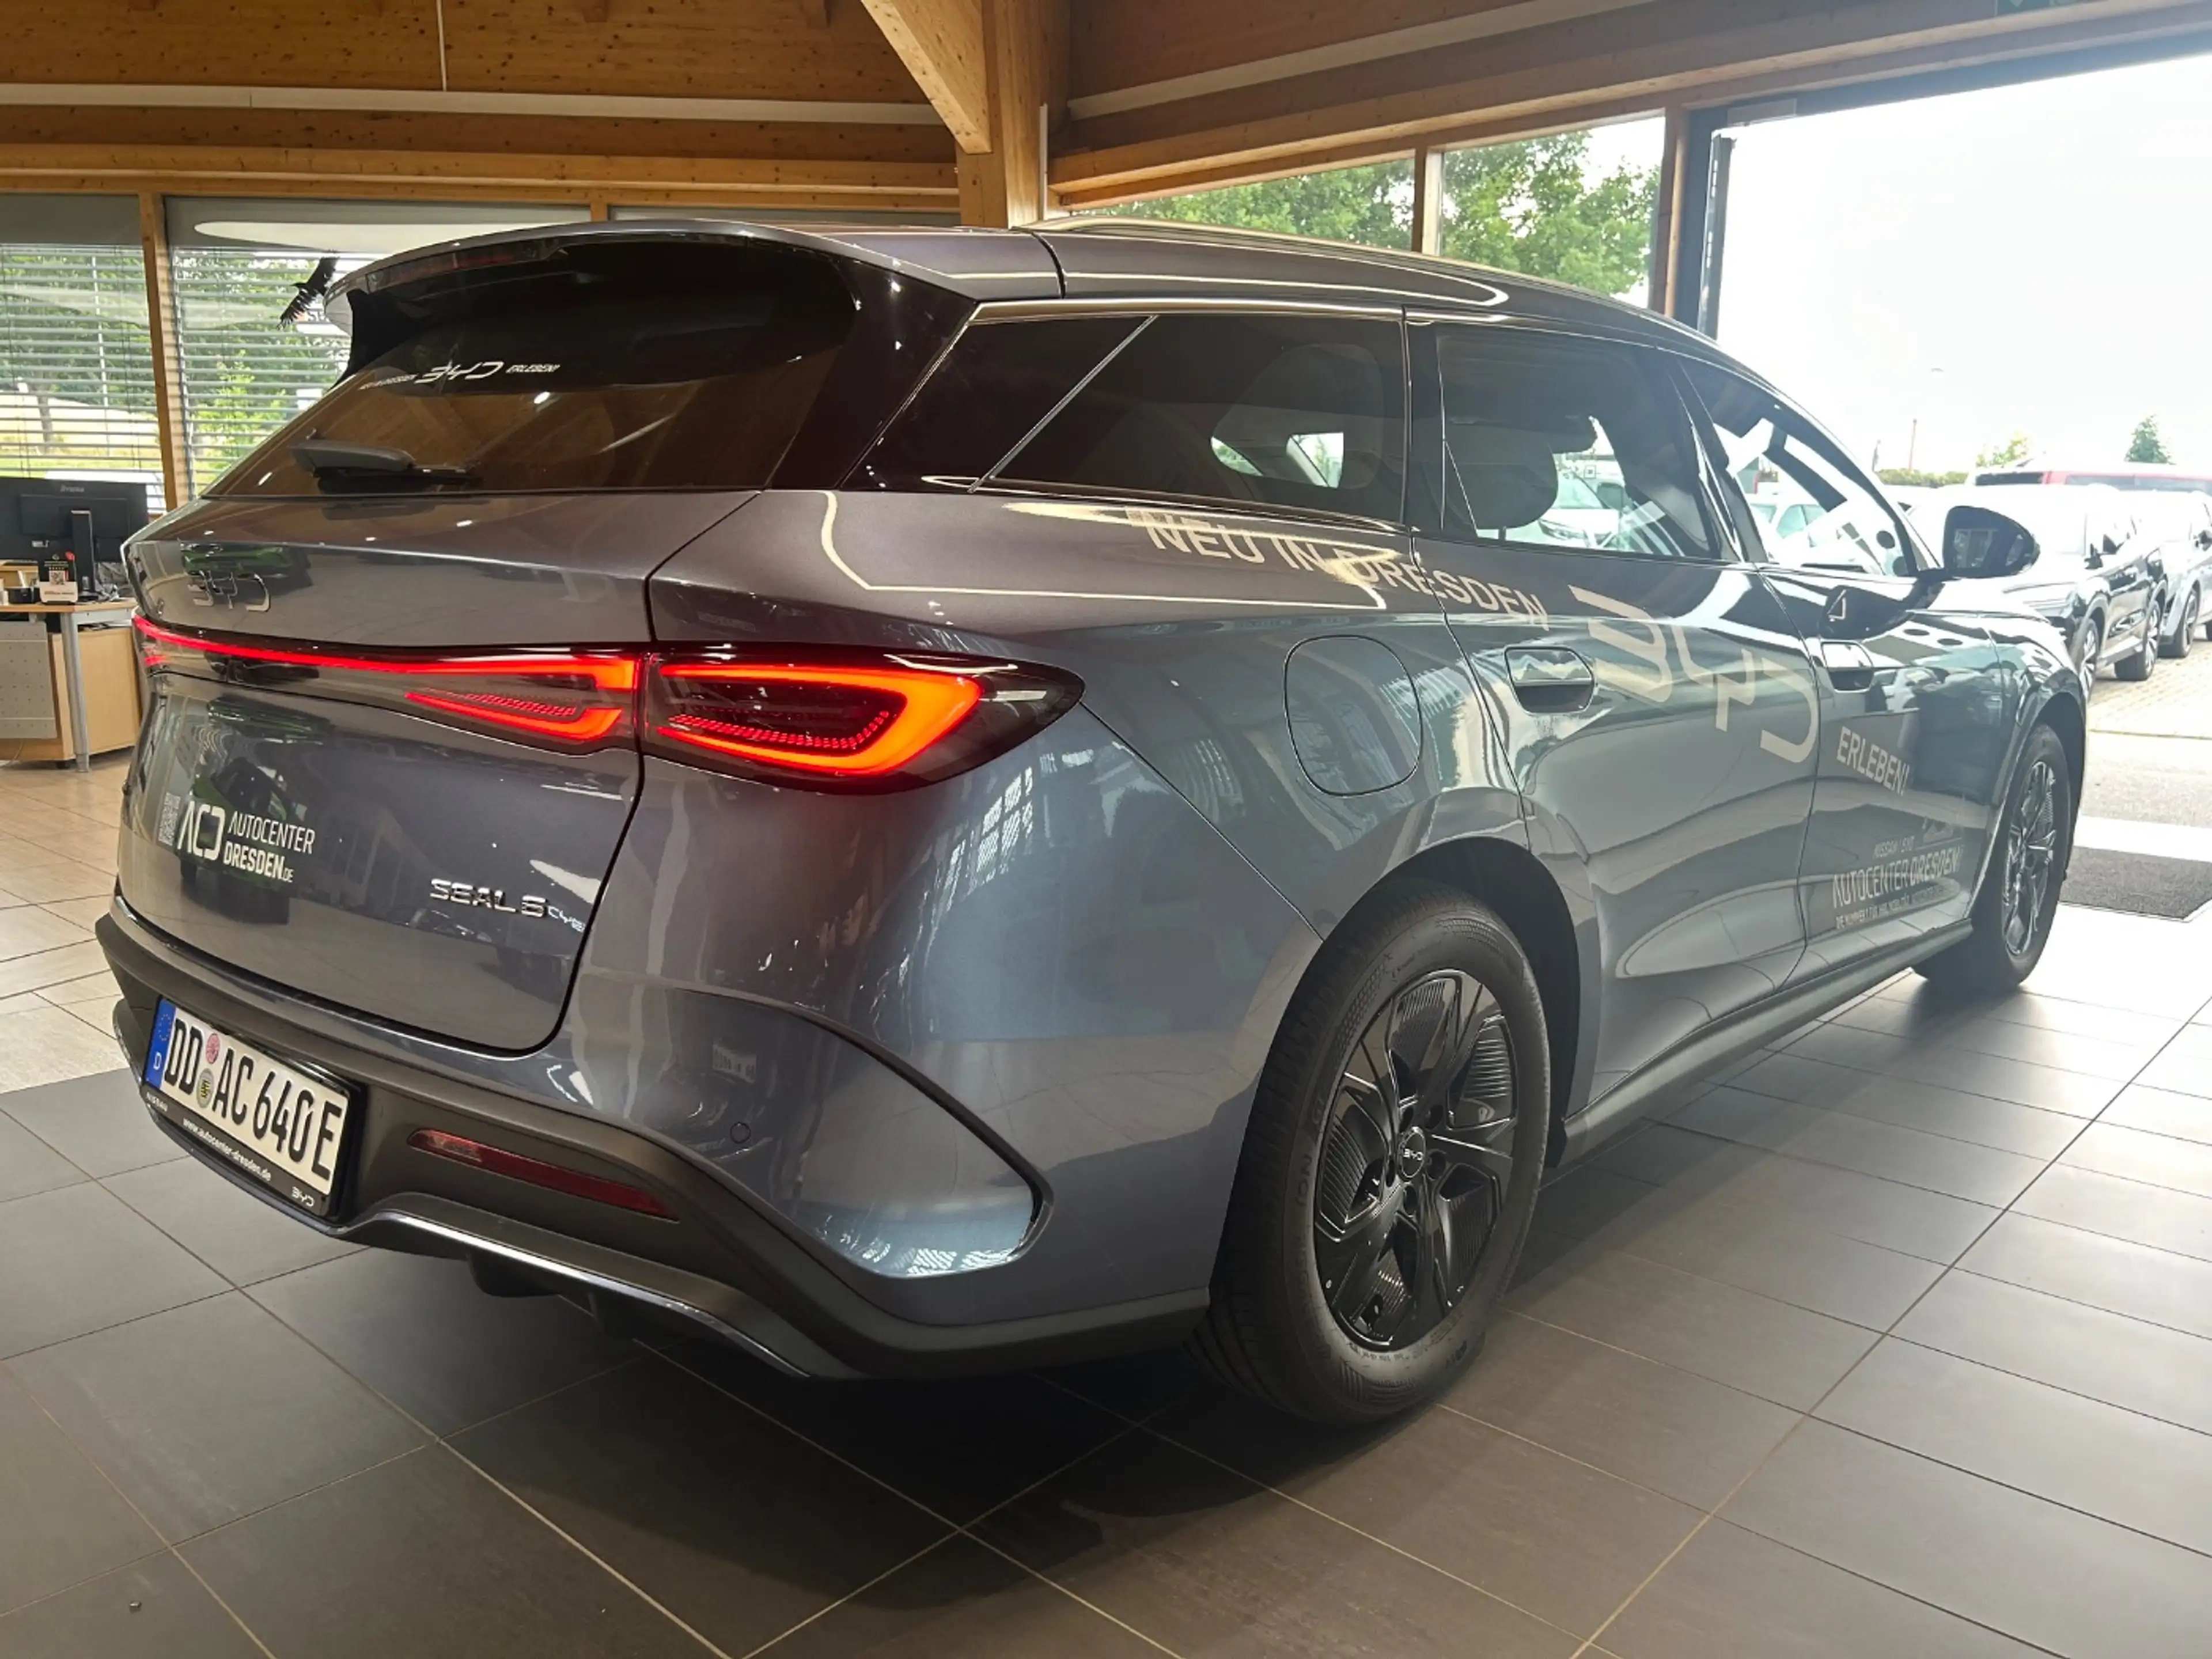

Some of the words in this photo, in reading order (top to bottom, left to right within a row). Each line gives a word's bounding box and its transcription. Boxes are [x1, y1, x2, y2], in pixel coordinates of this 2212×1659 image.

[1138, 510, 1265, 563] NEU
[1270, 537, 1338, 576] IN
[1332, 547, 1551, 631] DRESDEN
[1567, 585, 1819, 763] BYD
[1836, 726, 1910, 796] ERLEBEN!
[227, 810, 316, 854] AUTOCENTER
[430, 878, 516, 913] SEAL
[1832, 859, 1908, 908] AUTOCENTER
[153, 1052, 162, 1070] D
[164, 1018, 203, 1095] DD
[211, 1047, 254, 1126] AC
[183, 1118, 271, 1181] www.autocenter-dresden.de
[291, 1187, 315, 1207] BYD
